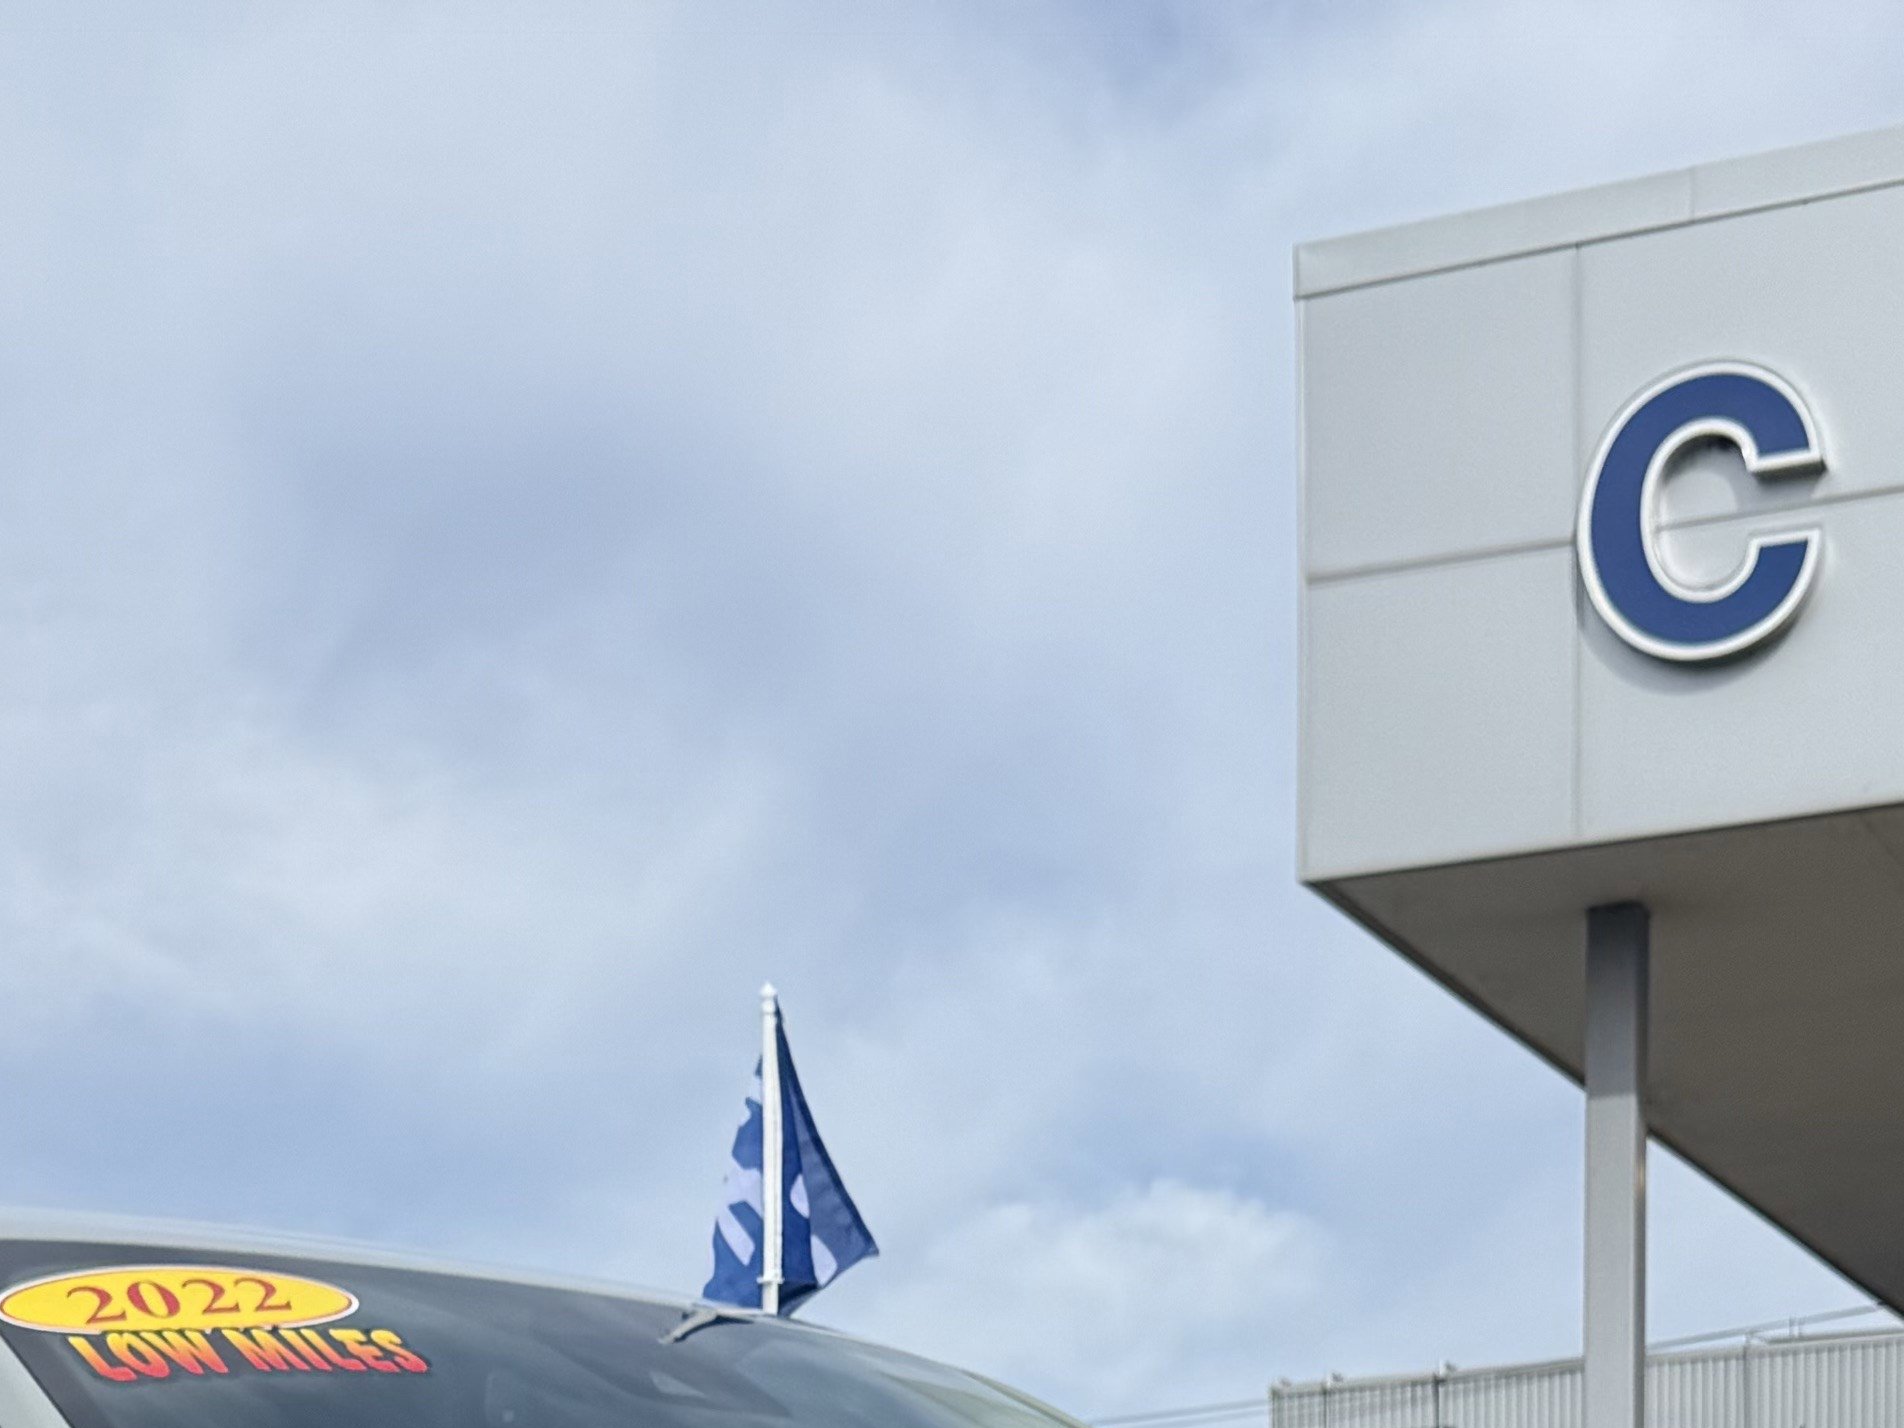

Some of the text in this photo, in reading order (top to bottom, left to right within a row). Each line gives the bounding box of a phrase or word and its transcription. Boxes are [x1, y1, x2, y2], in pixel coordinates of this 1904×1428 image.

[66, 1276, 293, 1326] 2022
[66, 1327, 430, 1384] LOW MILES
